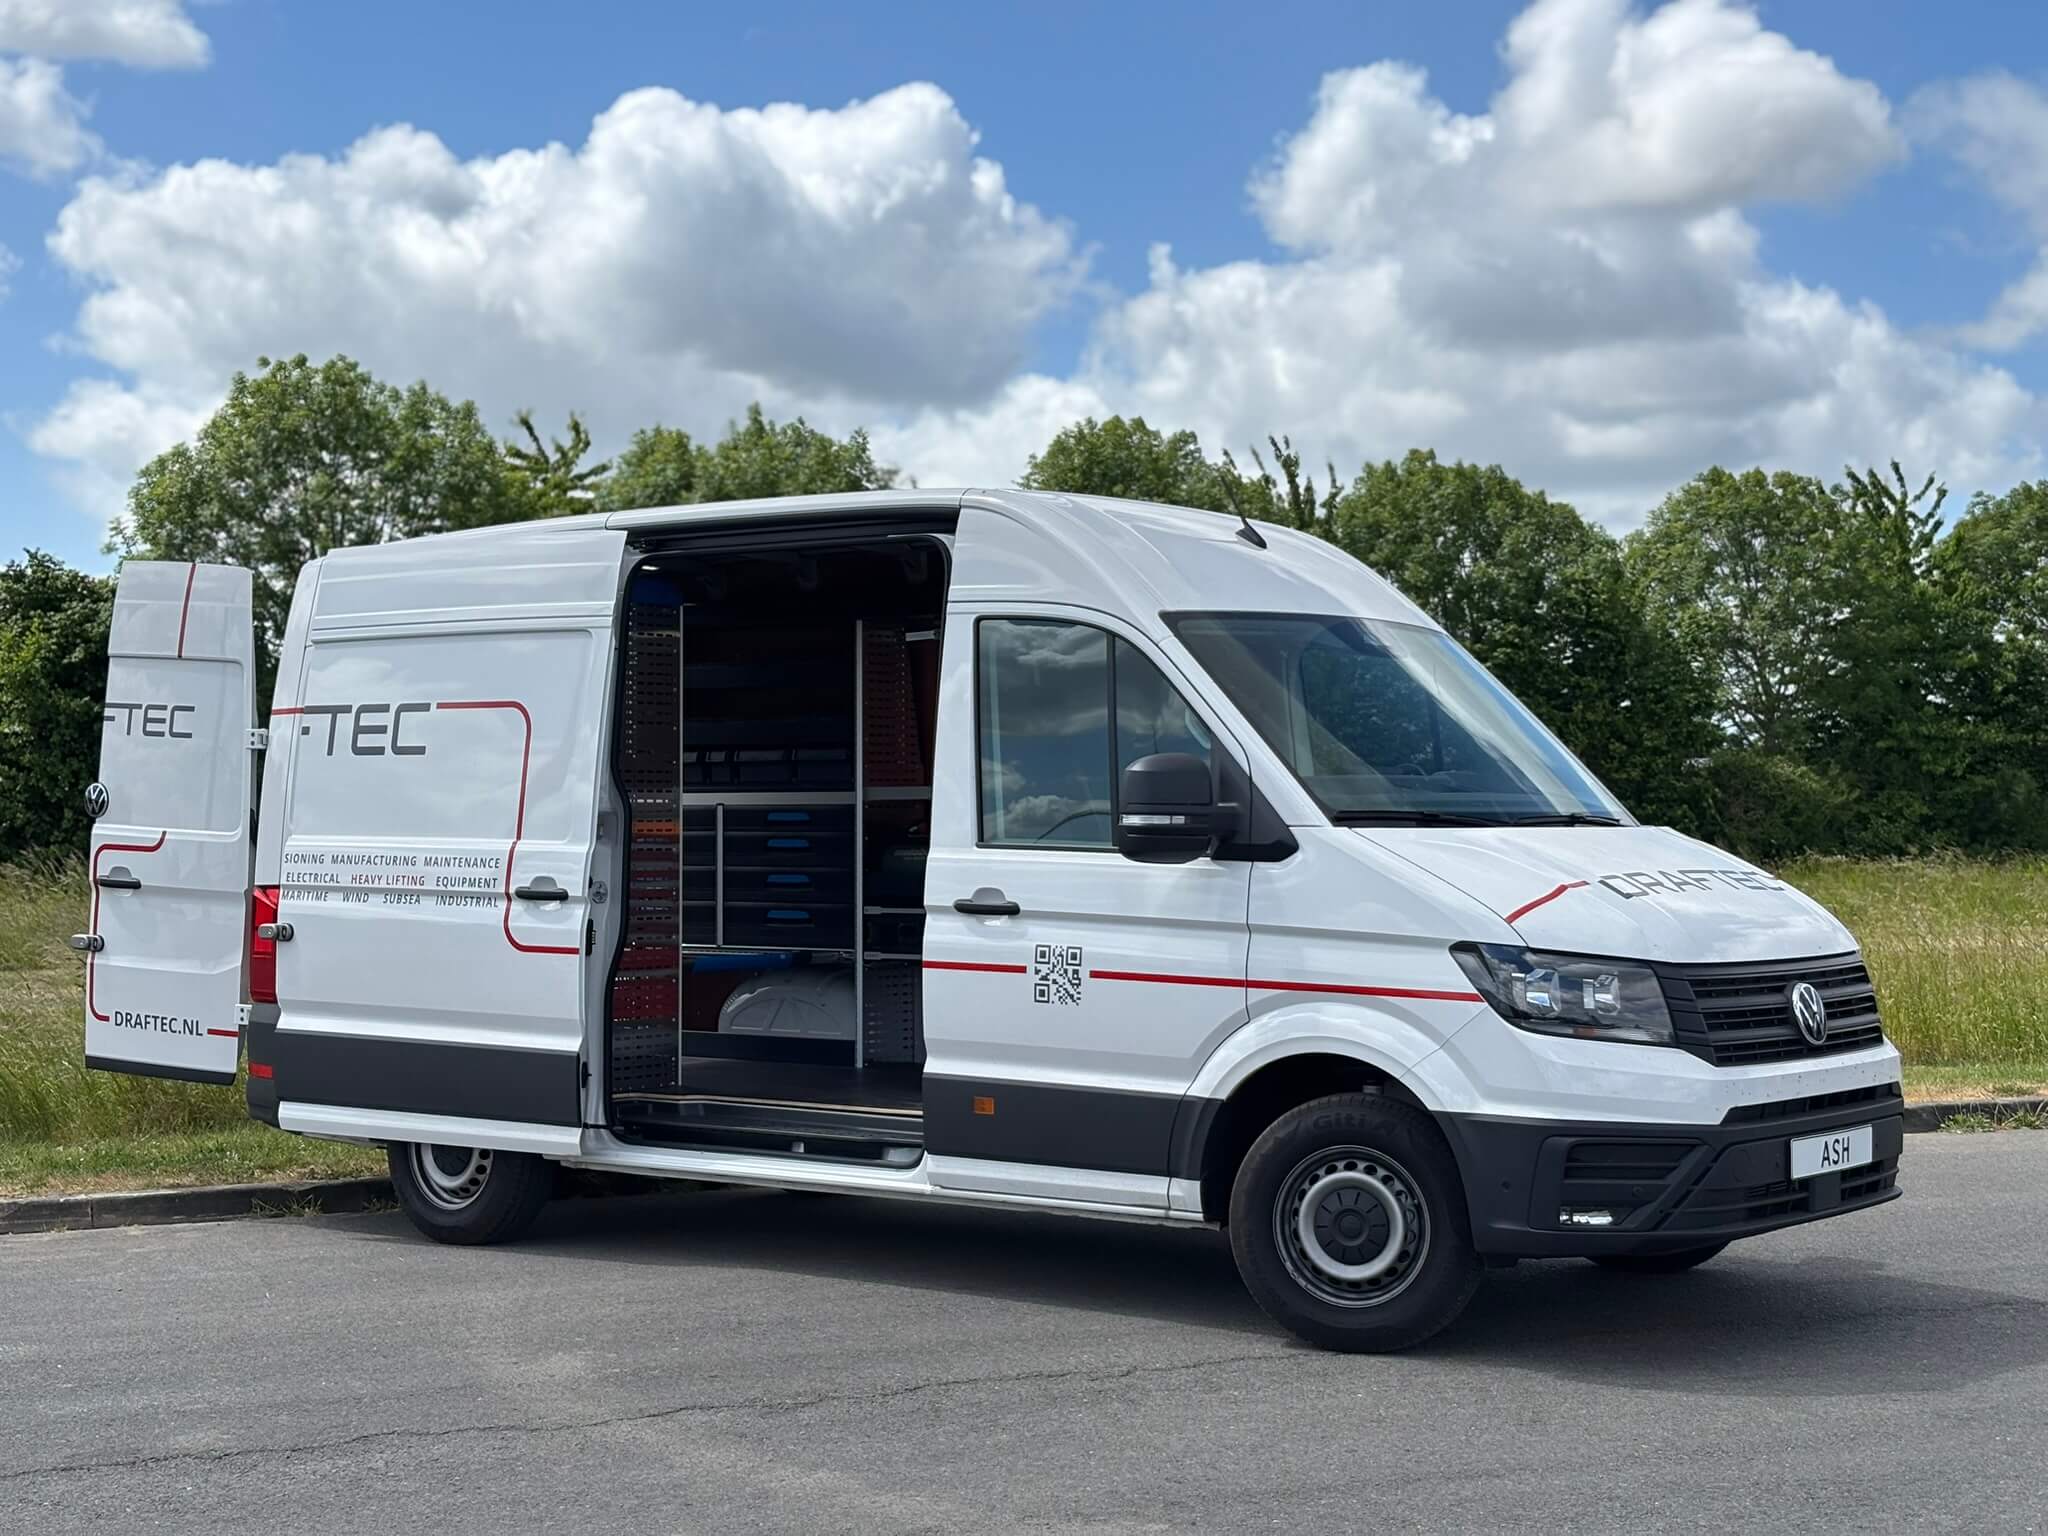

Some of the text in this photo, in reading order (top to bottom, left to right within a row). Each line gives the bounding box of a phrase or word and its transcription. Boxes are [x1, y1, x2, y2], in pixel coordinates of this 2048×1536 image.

[301, 702, 431, 756] TEC
[284, 852, 501, 869] SIONING MANUFACTURING MAINTENANCE
[286, 871, 498, 889] ELECTRICAL HEAVY LIFTING EQUIPMENT
[1598, 869, 1785, 900] DRAFTEC
[281, 889, 499, 908] MARITIME WIND SUBSEA INDUSTRIAL
[114, 1010, 204, 1037] DRAFTEC.NL
[1820, 1135, 1850, 1168] ASH
